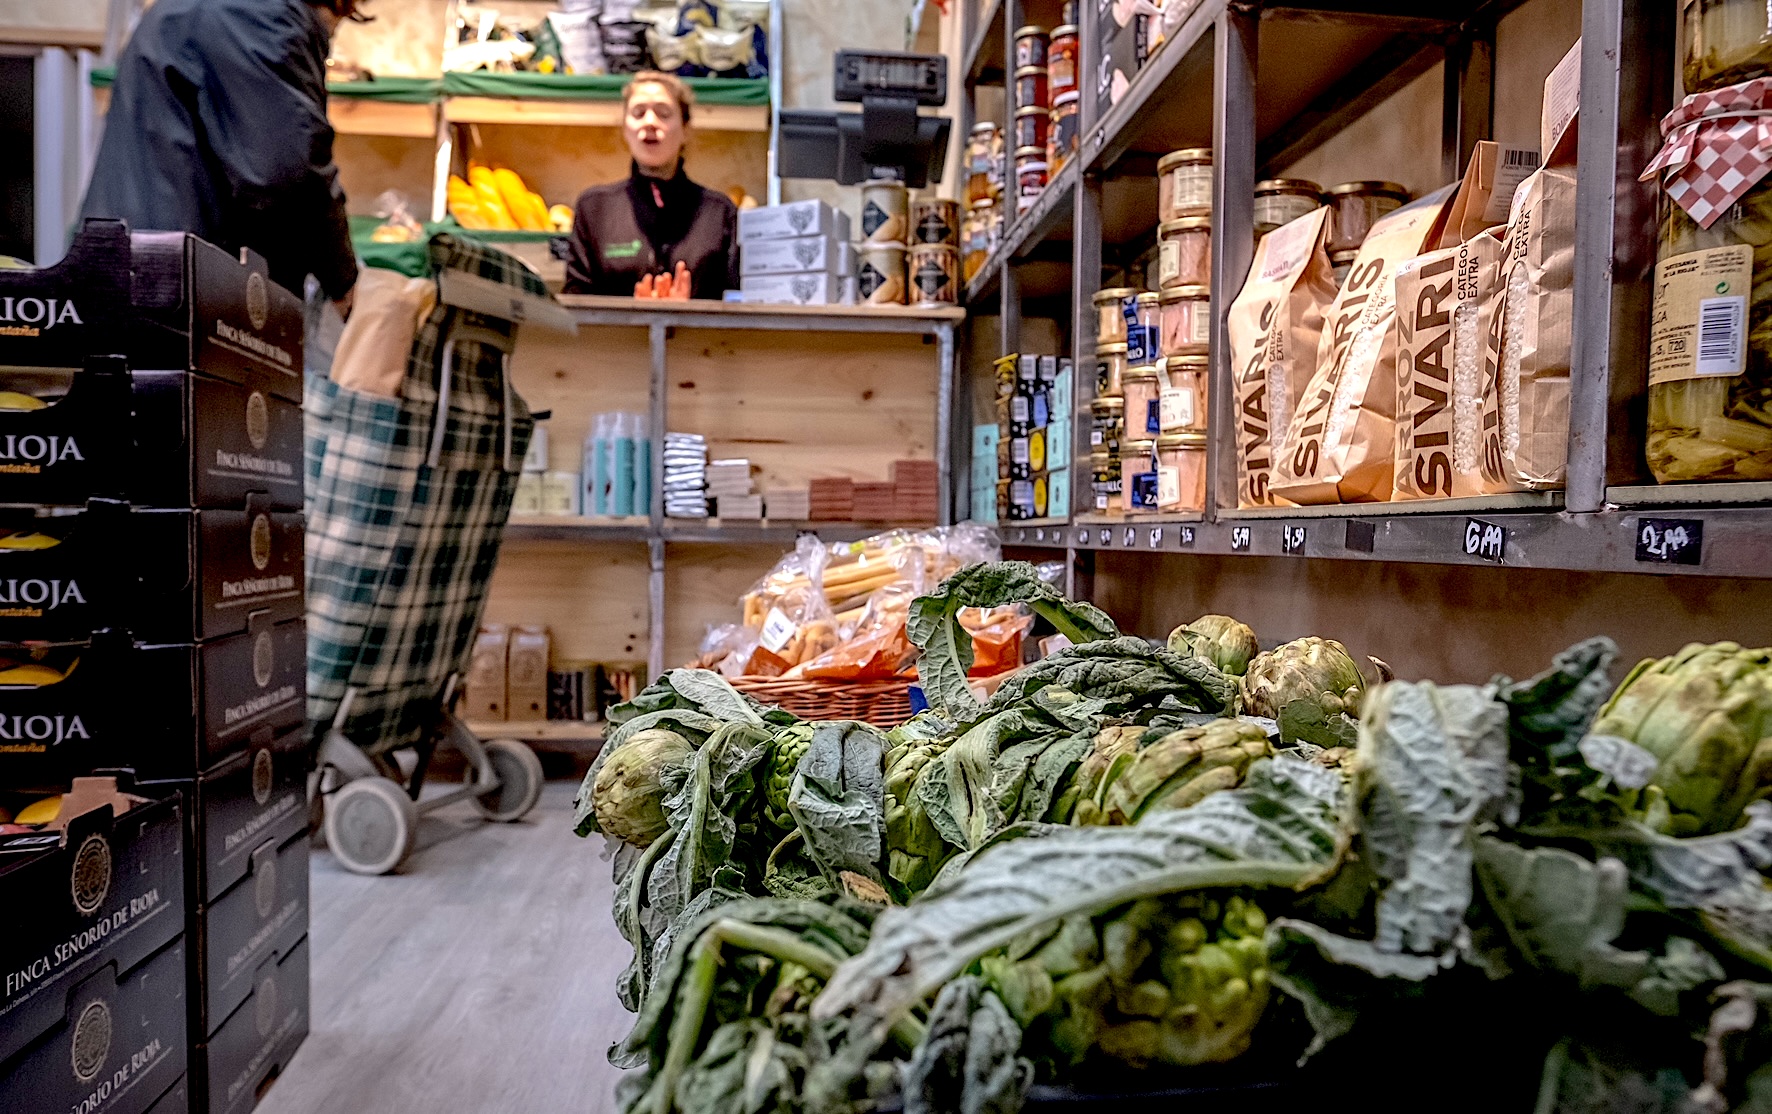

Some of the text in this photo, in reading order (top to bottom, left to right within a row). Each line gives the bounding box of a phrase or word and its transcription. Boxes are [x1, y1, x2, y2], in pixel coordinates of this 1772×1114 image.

[1519, 209, 1532, 258] EXTRA
[1467, 256, 1479, 298] EXTRA
[0, 297, 84, 330] IOJA
[1276, 330, 1285, 361] EXTRA
[1294, 258, 1385, 478] SIVARIS
[1668, 339, 1685, 352] 720
[1414, 256, 1455, 498] SIVARI
[1395, 311, 1421, 498] ARROZ
[1465, 521, 1502, 556] 6,99
[6, 956, 51, 997] FINCA
[113, 906, 129, 929] DE
[130, 888, 160, 918] RIOJA
[113, 1063, 130, 1090] DE
[131, 1038, 161, 1074] RIOJA
